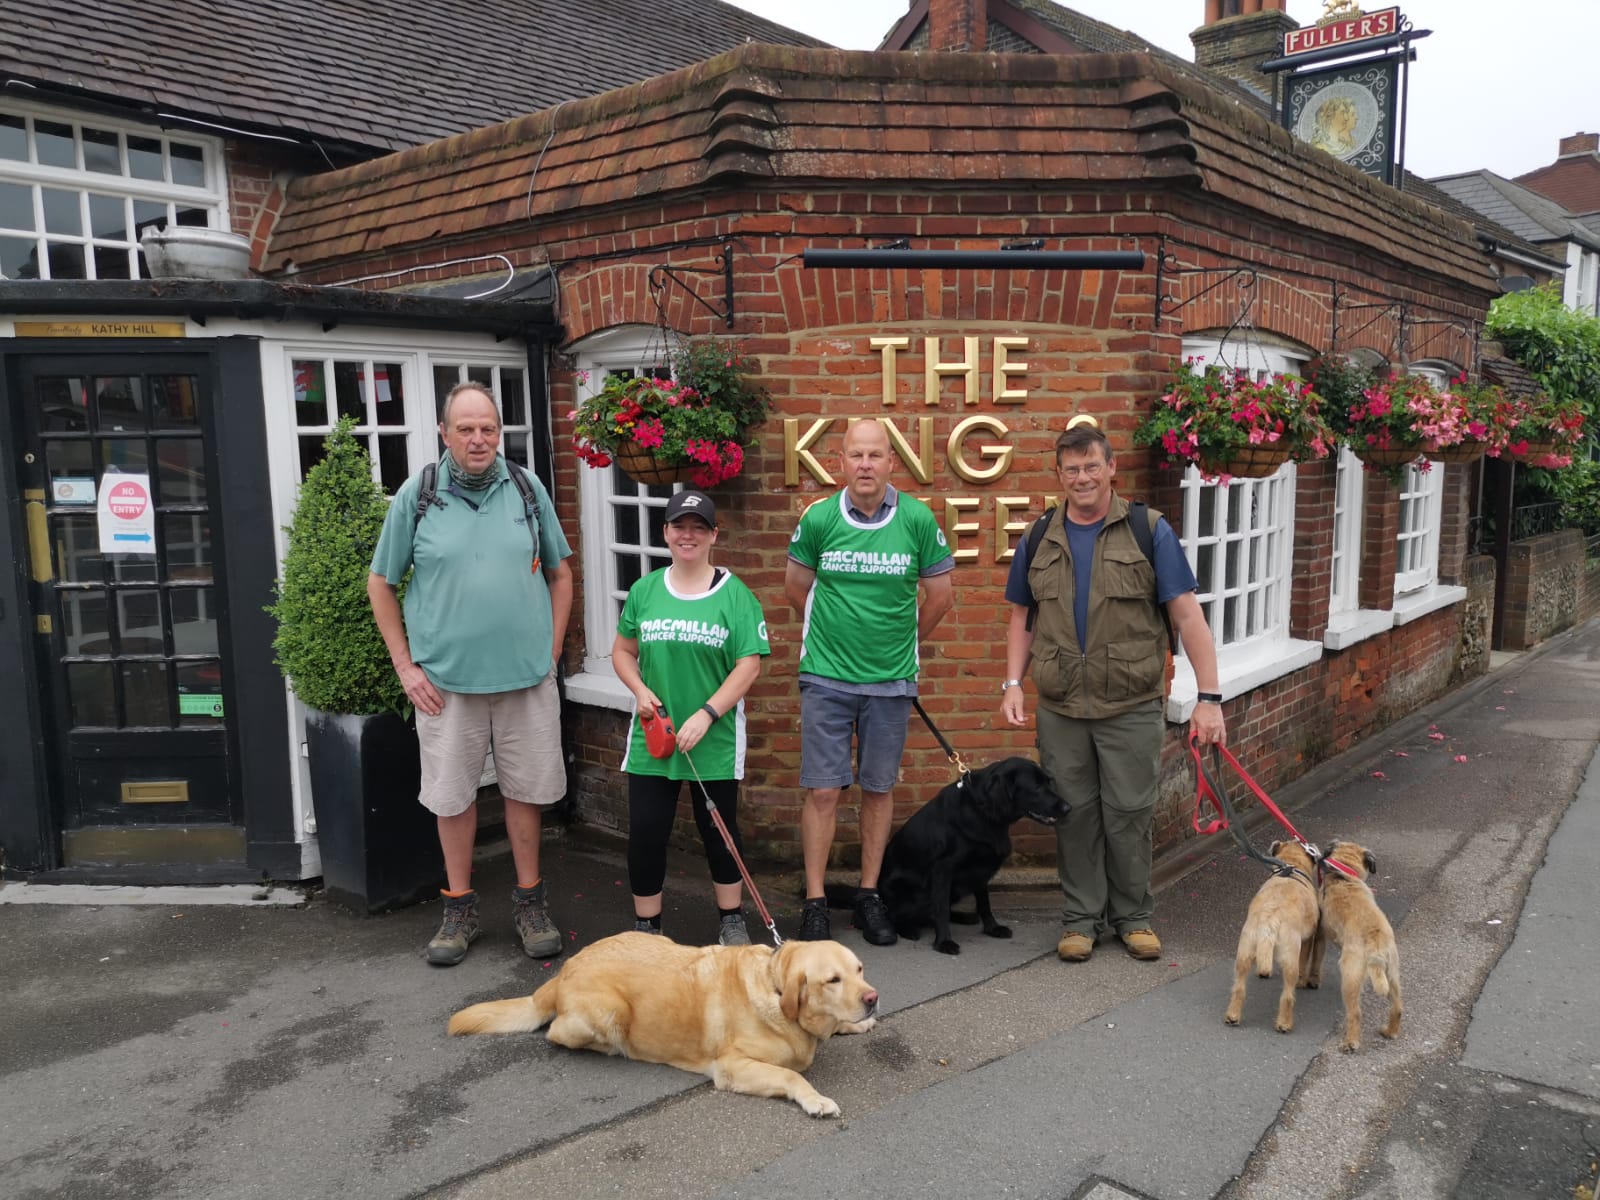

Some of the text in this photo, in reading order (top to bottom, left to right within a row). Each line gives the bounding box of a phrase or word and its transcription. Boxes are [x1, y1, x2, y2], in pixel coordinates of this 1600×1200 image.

[1289, 15, 1388, 50] FULLER'S
[91, 324, 128, 335] KATHY
[133, 325, 156, 334] HILL
[869, 336, 1030, 405] THE
[783, 415, 1014, 487] KNG
[122, 487, 135, 496] NO
[113, 505, 142, 515] ENTRY
[820, 551, 911, 566] MACMILLAN
[821, 562, 907, 576] CANCER SUPPORT
[640, 618, 729, 640] MACMILLAN
[641, 631, 724, 649] CANCER SUPPORT
